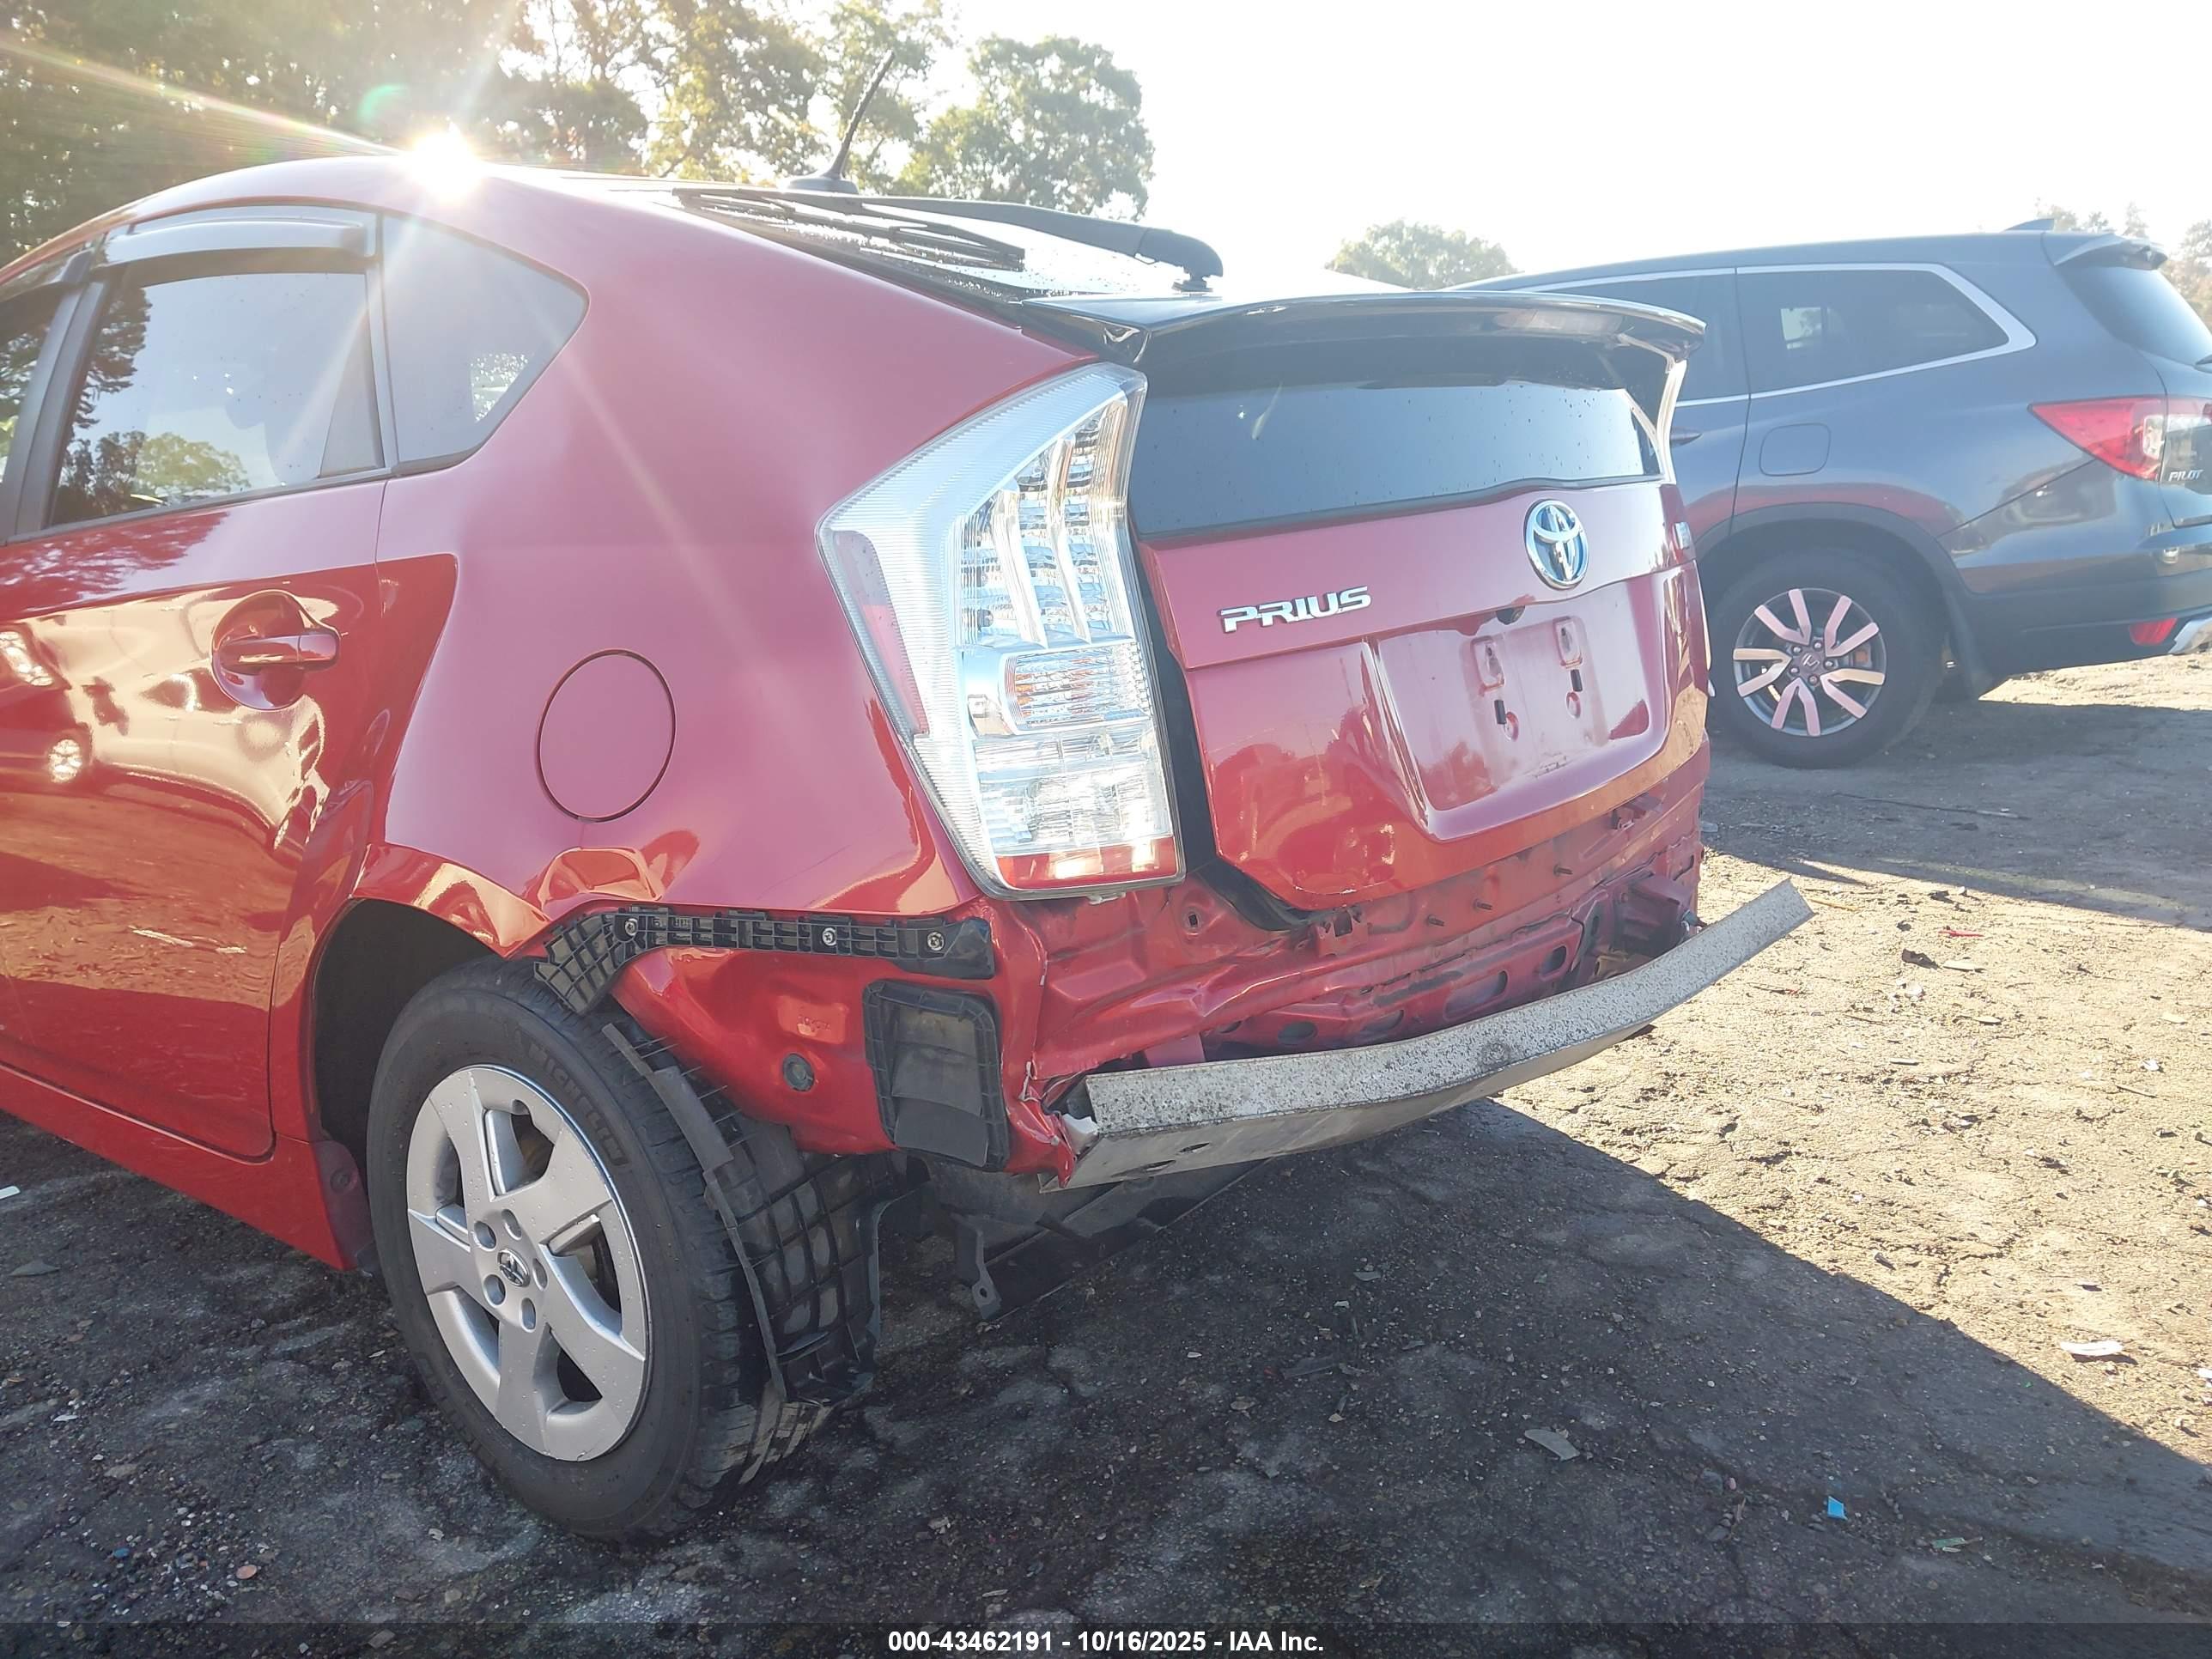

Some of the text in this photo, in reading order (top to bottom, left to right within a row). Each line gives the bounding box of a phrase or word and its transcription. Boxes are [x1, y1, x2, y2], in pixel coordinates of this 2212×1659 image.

[2168, 469, 2204, 482] PILOT
[1218, 586, 1371, 633] PRIUS
[528, 1040, 629, 1166] MICHELIN
